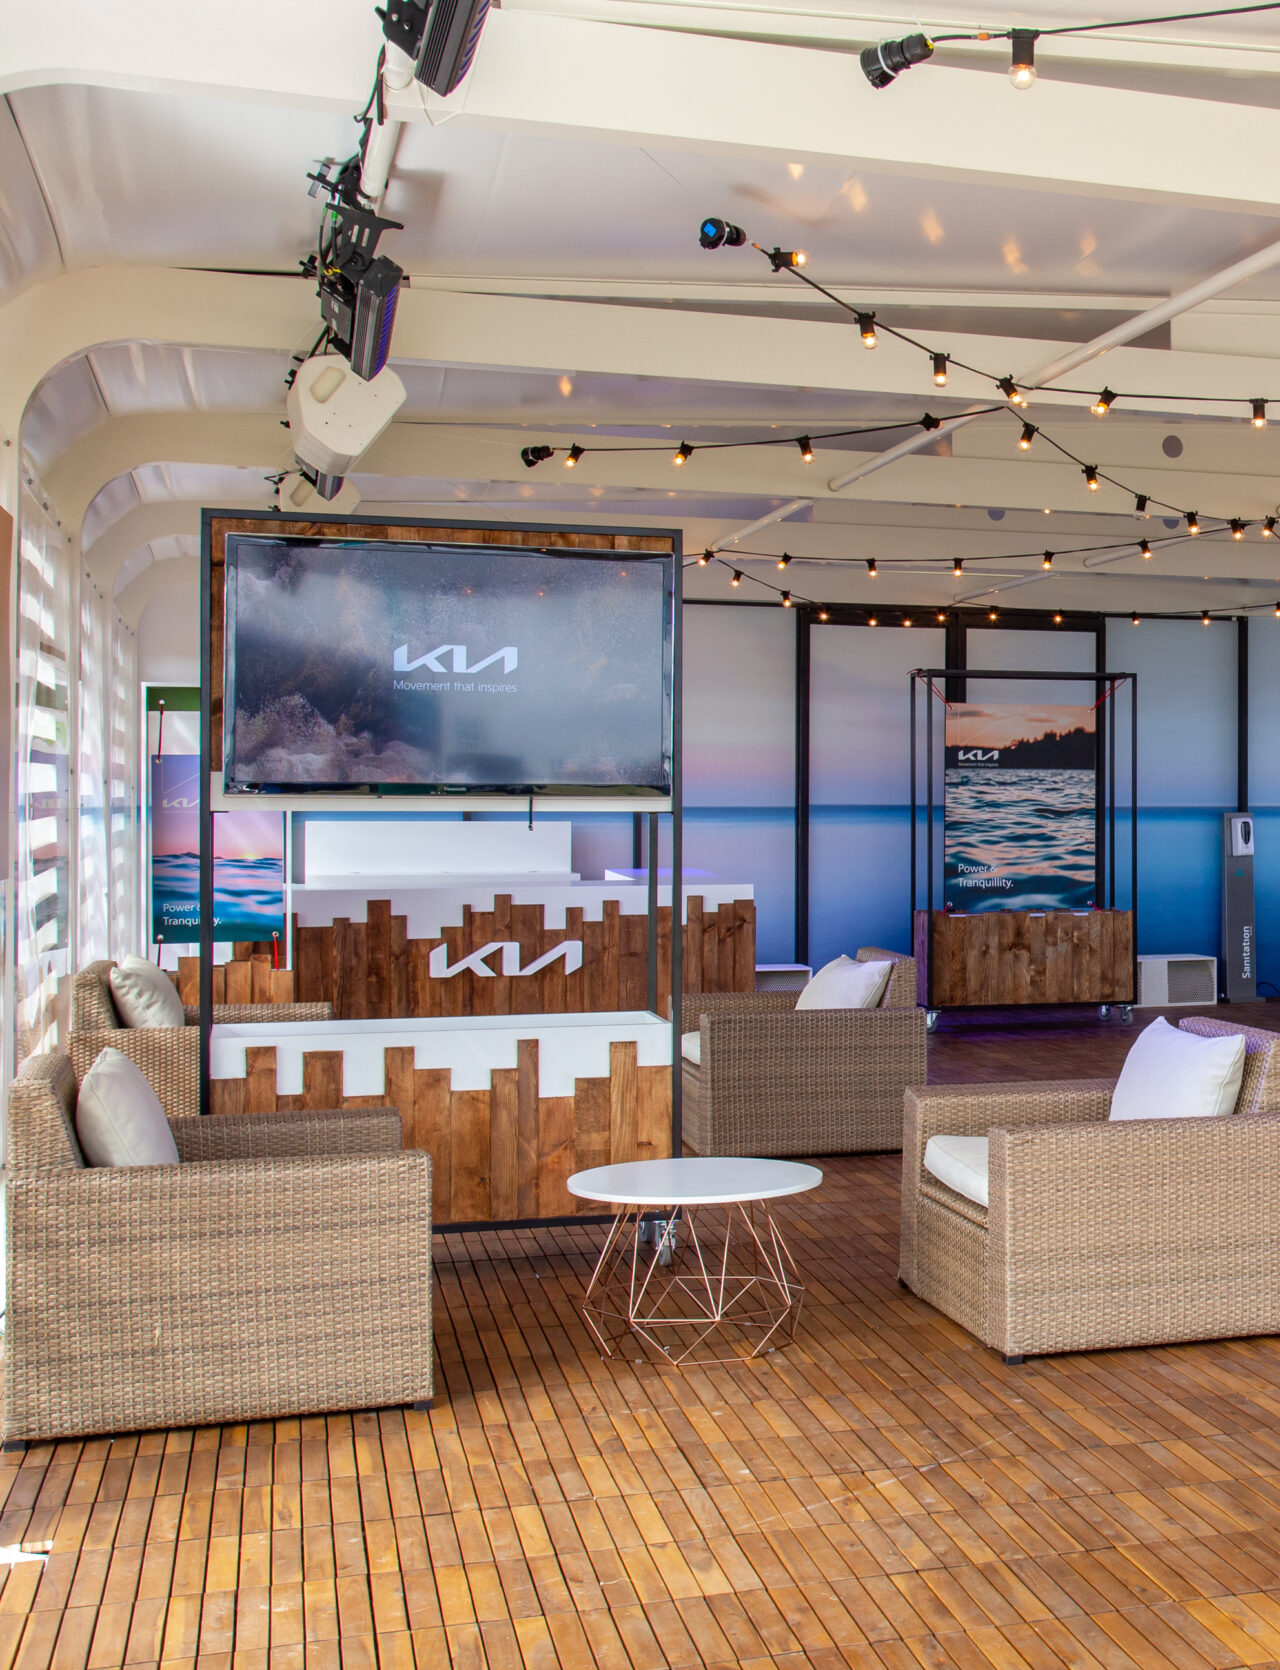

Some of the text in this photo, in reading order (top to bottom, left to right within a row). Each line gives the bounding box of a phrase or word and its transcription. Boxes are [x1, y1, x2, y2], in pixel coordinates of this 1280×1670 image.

[393, 643, 518, 674] KIA
[393, 679, 518, 694] Movement that inspires
[958, 749, 999, 760] KIA
[958, 863, 998, 873] Power &
[958, 877, 1014, 889] Tranquillity.
[163, 903, 195, 912] Power
[163, 916, 221, 927] Tranquy.
[1241, 926, 1251, 979] Sanitation
[429, 940, 583, 979] KIA
